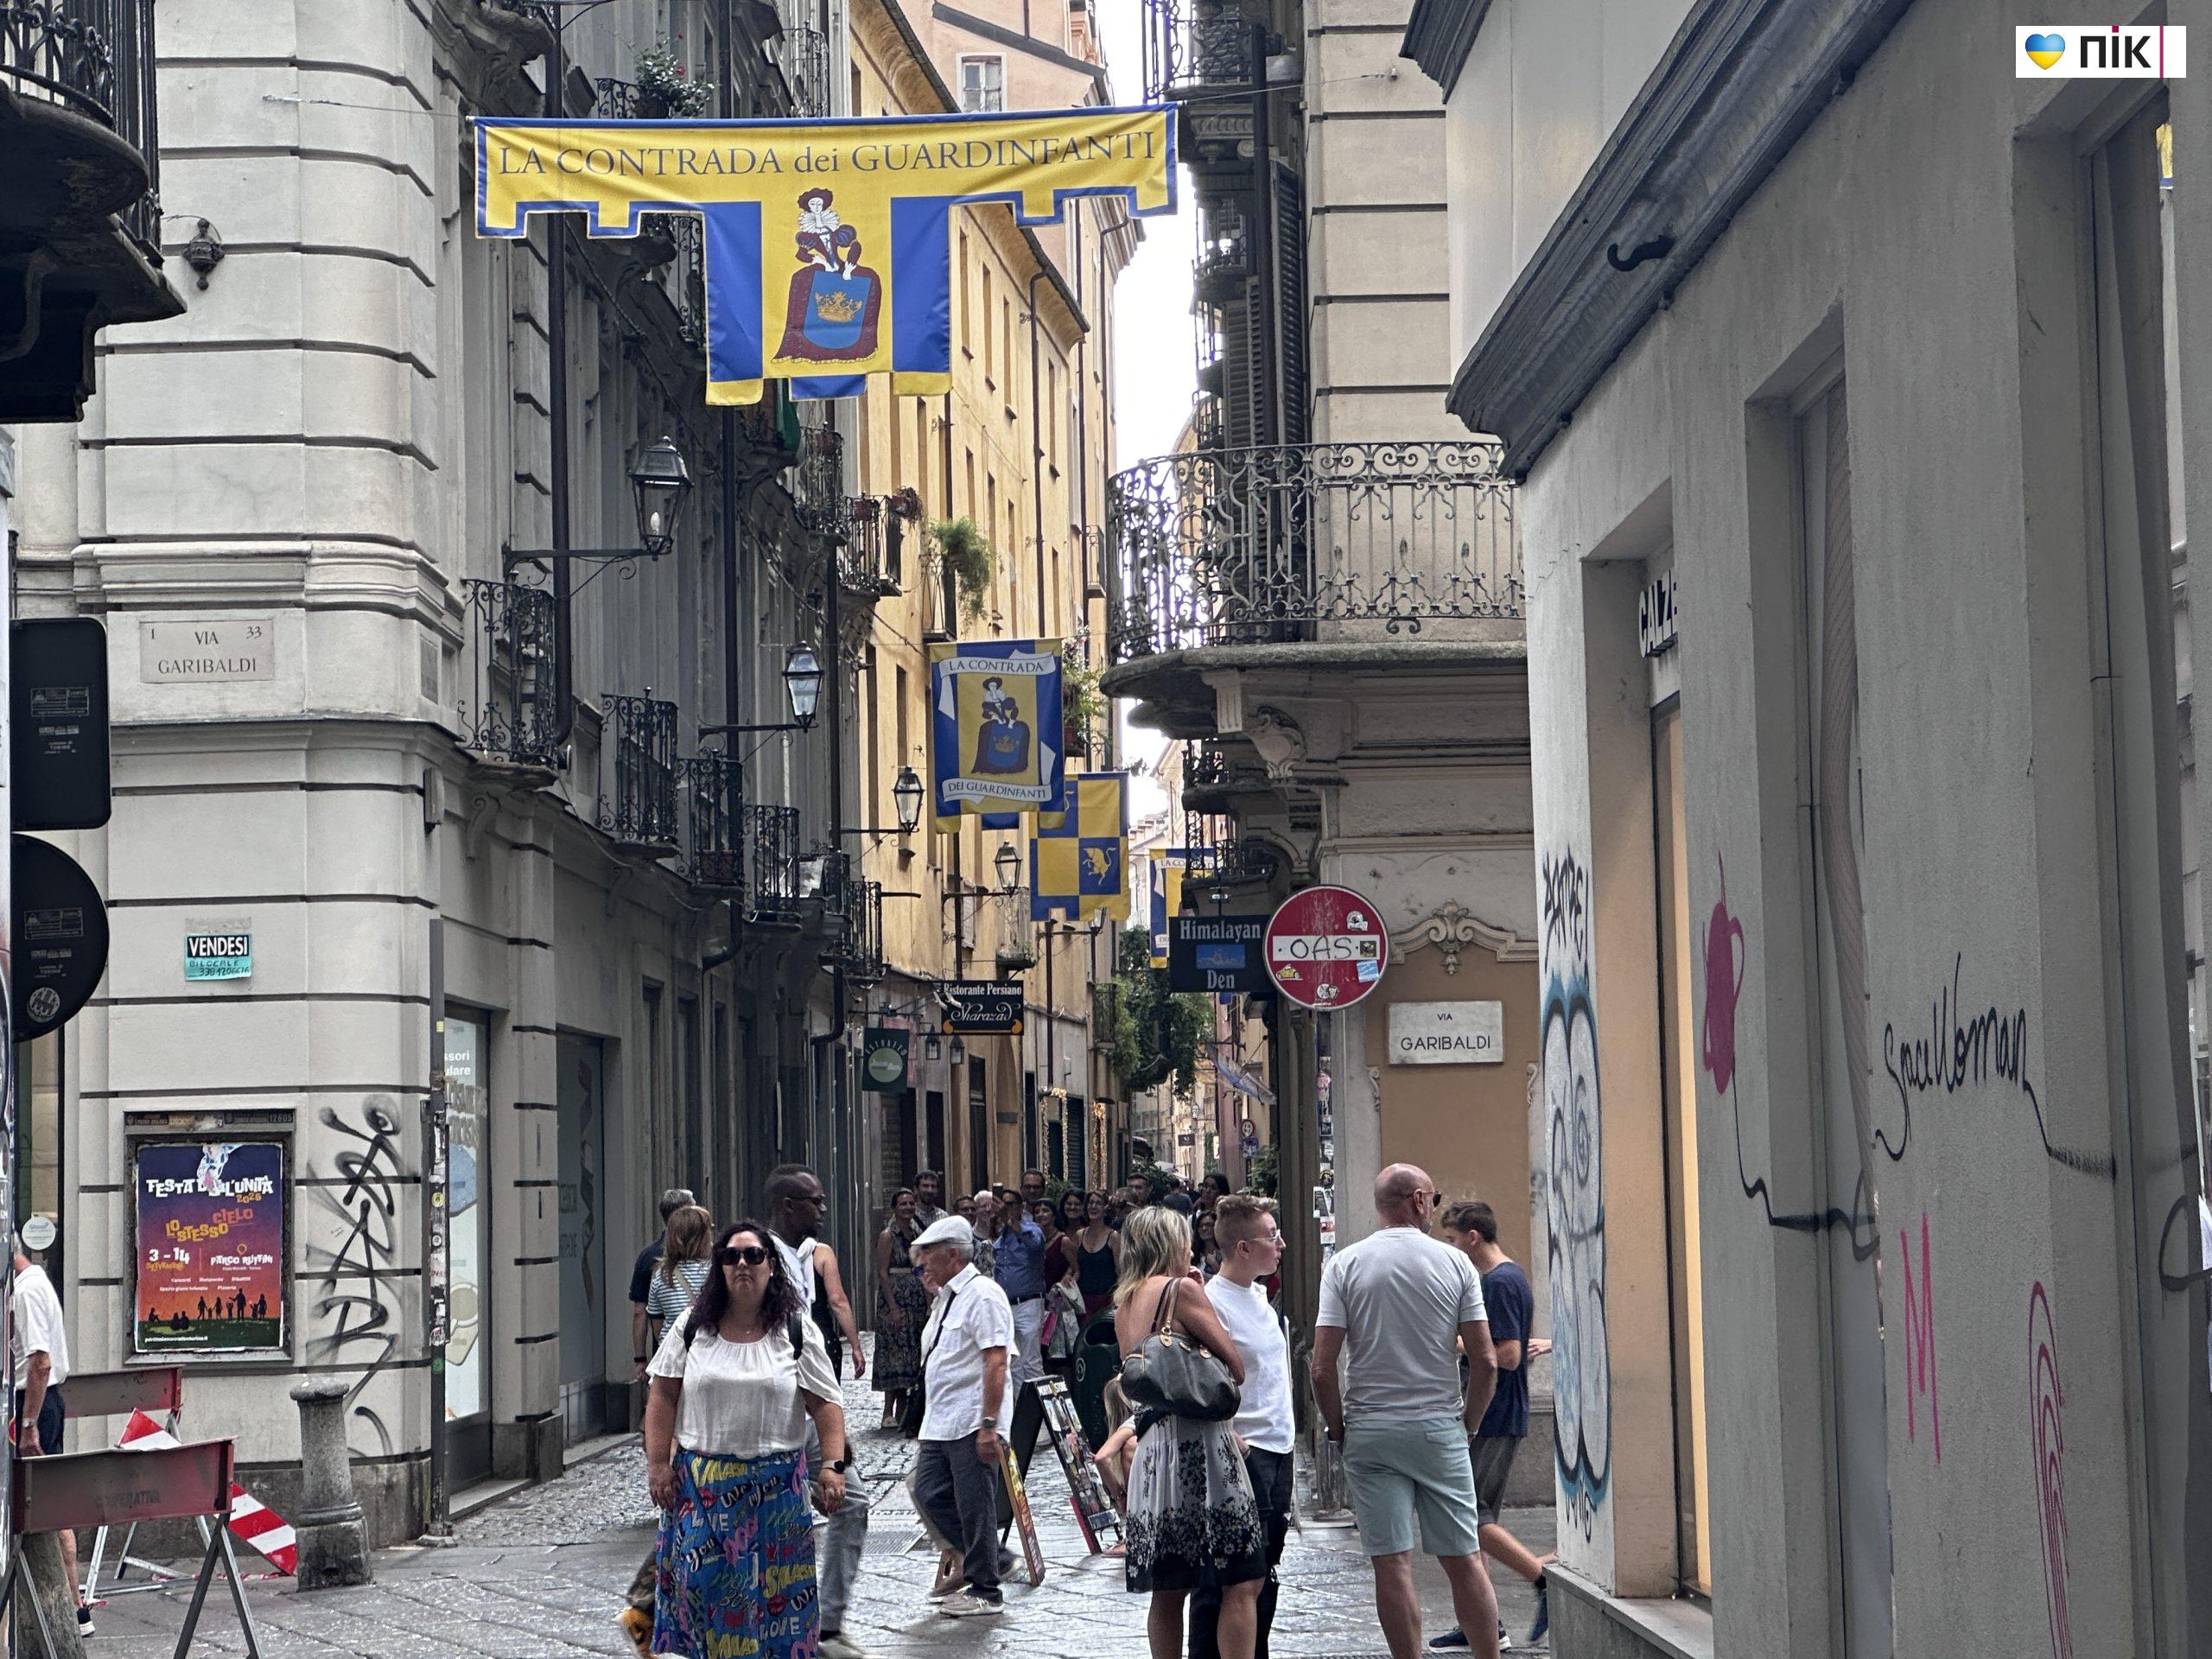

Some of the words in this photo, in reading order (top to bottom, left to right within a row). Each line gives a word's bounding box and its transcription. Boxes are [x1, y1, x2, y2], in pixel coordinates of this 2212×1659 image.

[499, 147, 546, 175] LA
[555, 147, 784, 176] CONTRADA
[792, 144, 840, 175] dei
[850, 130, 1155, 173] GUARDINFANTI
[194, 631, 219, 645] VIA
[245, 626, 263, 639] 33
[157, 658, 257, 675] GARIBALDI
[949, 660, 965, 671] LA
[968, 659, 1045, 673] CONTRADA
[948, 781, 964, 792] DEI
[966, 782, 1047, 799] GUARDINFANTI
[1179, 918, 1262, 944] Himalayan
[188, 936, 248, 957] VENDESI
[943, 983, 985, 995] Ristorante
[987, 982, 1022, 995] Persiano
[1206, 969, 1236, 990] Den
[1401, 1036, 1491, 1051] GARIBALDI
[146, 1178, 195, 1198] FESTA
[213, 1208, 254, 1224] CIELO
[165, 1219, 180, 1236] LO
[177, 1223, 229, 1243] STESSO
[149, 1249, 159, 1262] 3
[173, 1247, 190, 1265] 14
